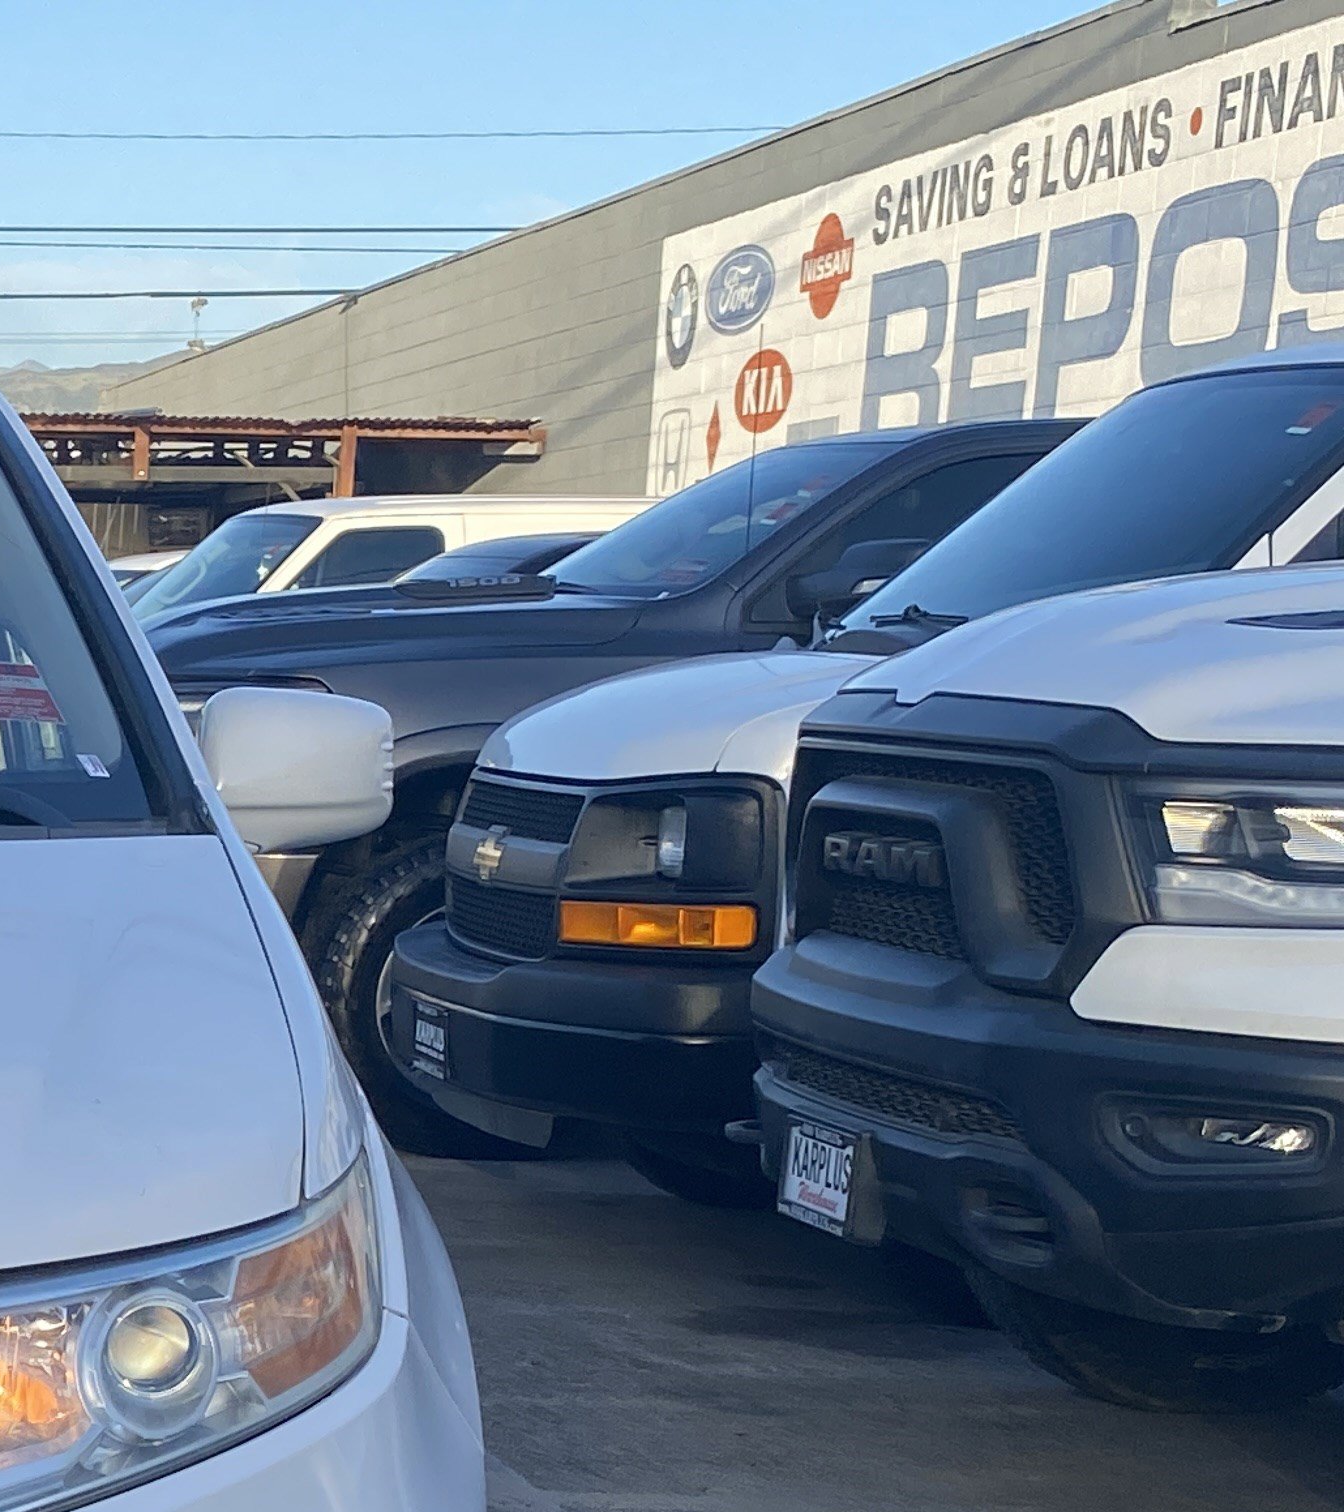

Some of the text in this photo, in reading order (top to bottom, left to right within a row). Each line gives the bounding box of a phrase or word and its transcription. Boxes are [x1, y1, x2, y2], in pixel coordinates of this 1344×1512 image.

[872, 152, 994, 246] SAVING
[1007, 142, 1029, 206] &
[1039, 98, 1172, 198] LOANS
[718, 265, 761, 316] Ford
[802, 248, 852, 286] NISSAN
[742, 365, 784, 416] KIA
[823, 833, 945, 887] RAM
[791, 1136, 852, 1194] KARPLUS
